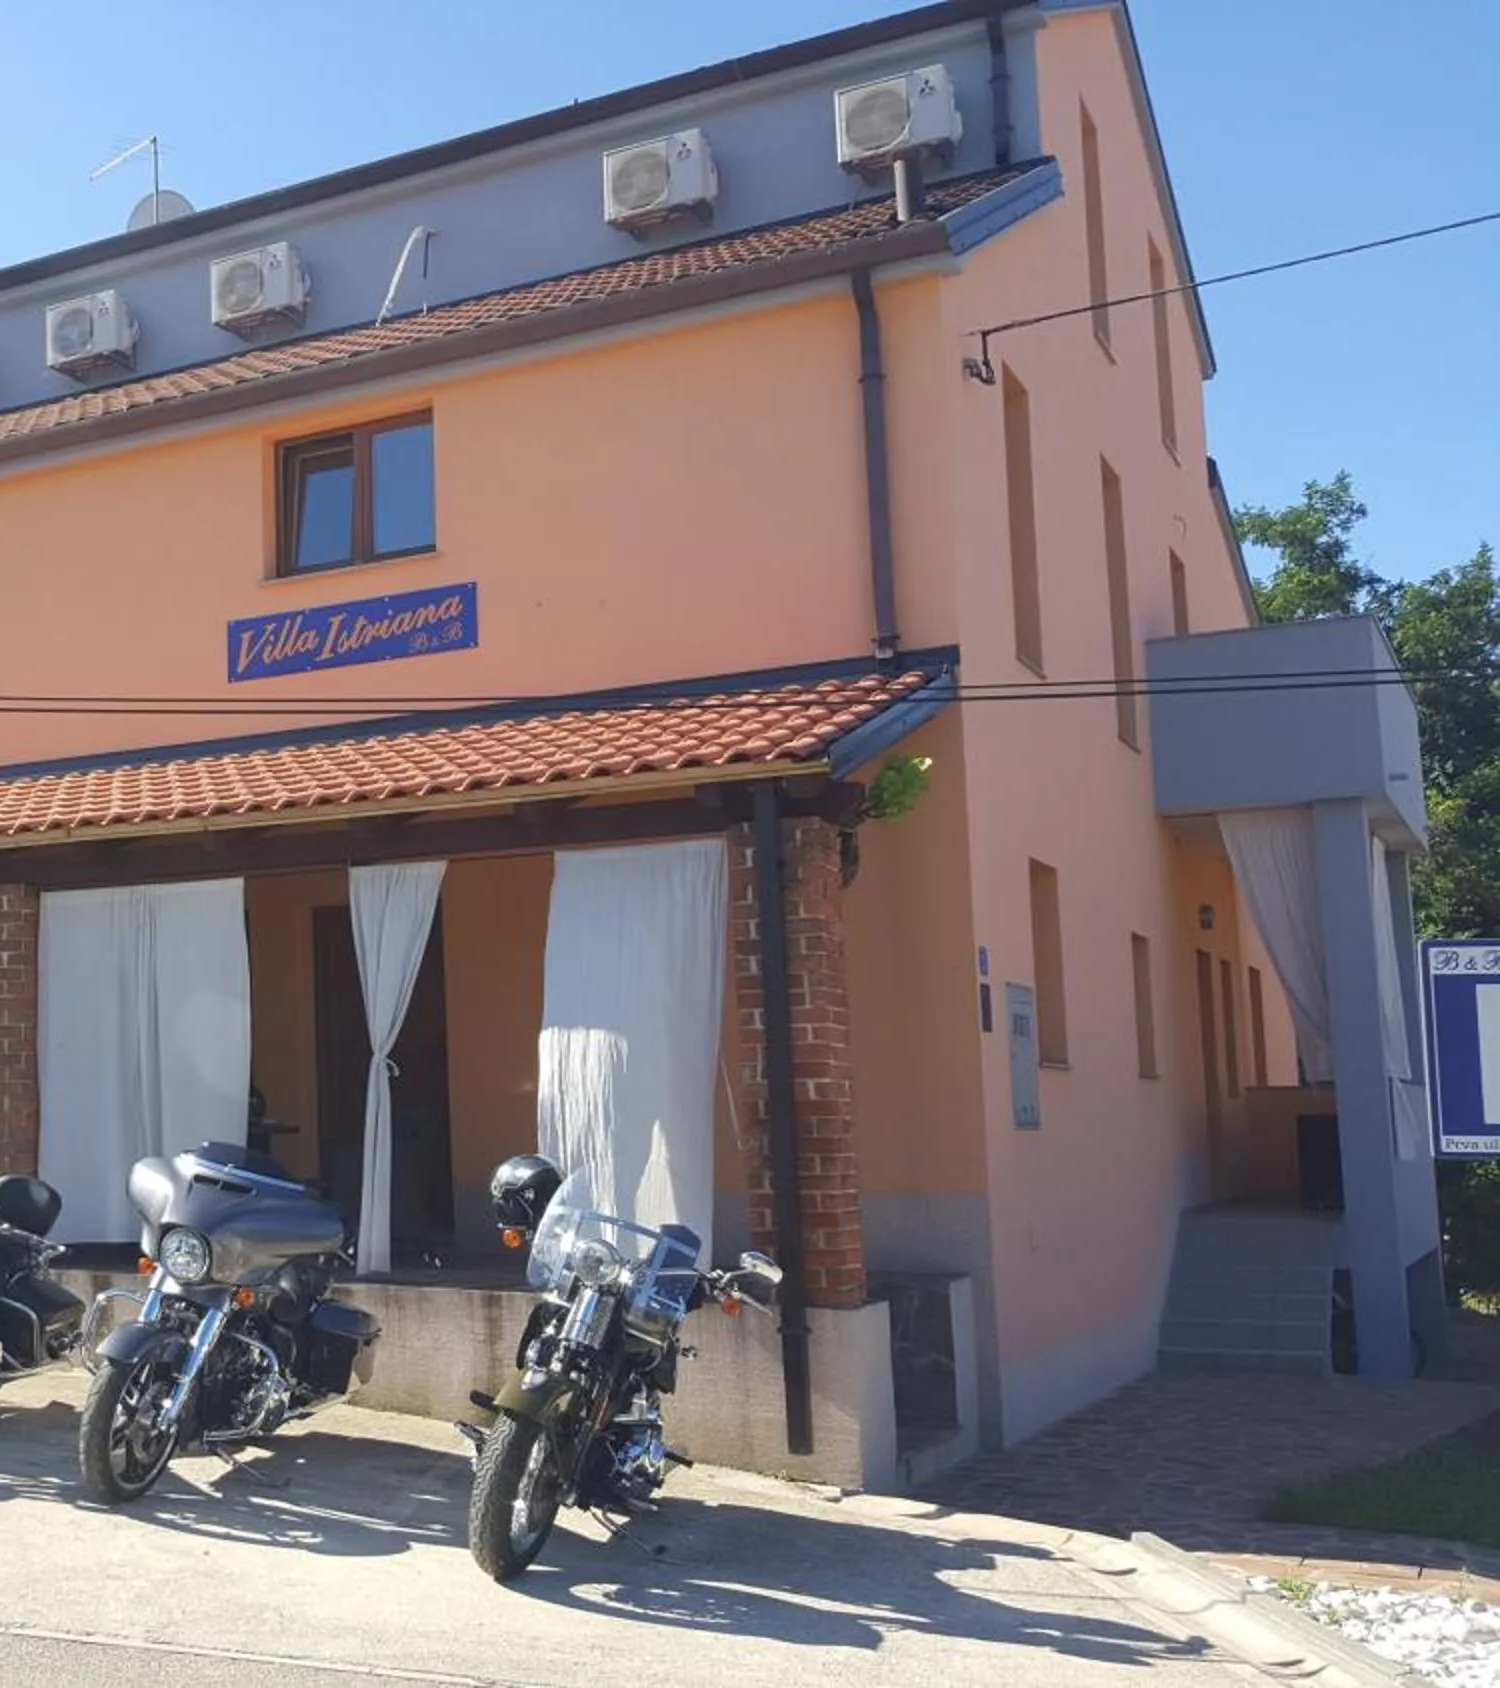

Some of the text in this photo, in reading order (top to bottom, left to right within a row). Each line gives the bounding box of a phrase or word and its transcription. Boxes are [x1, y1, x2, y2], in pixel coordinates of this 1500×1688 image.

[237, 595, 463, 673] Villa Istriana
[1432, 950, 1460, 971] B
[1464, 956, 1478, 970] &
[1445, 1138, 1479, 1149] Prva
